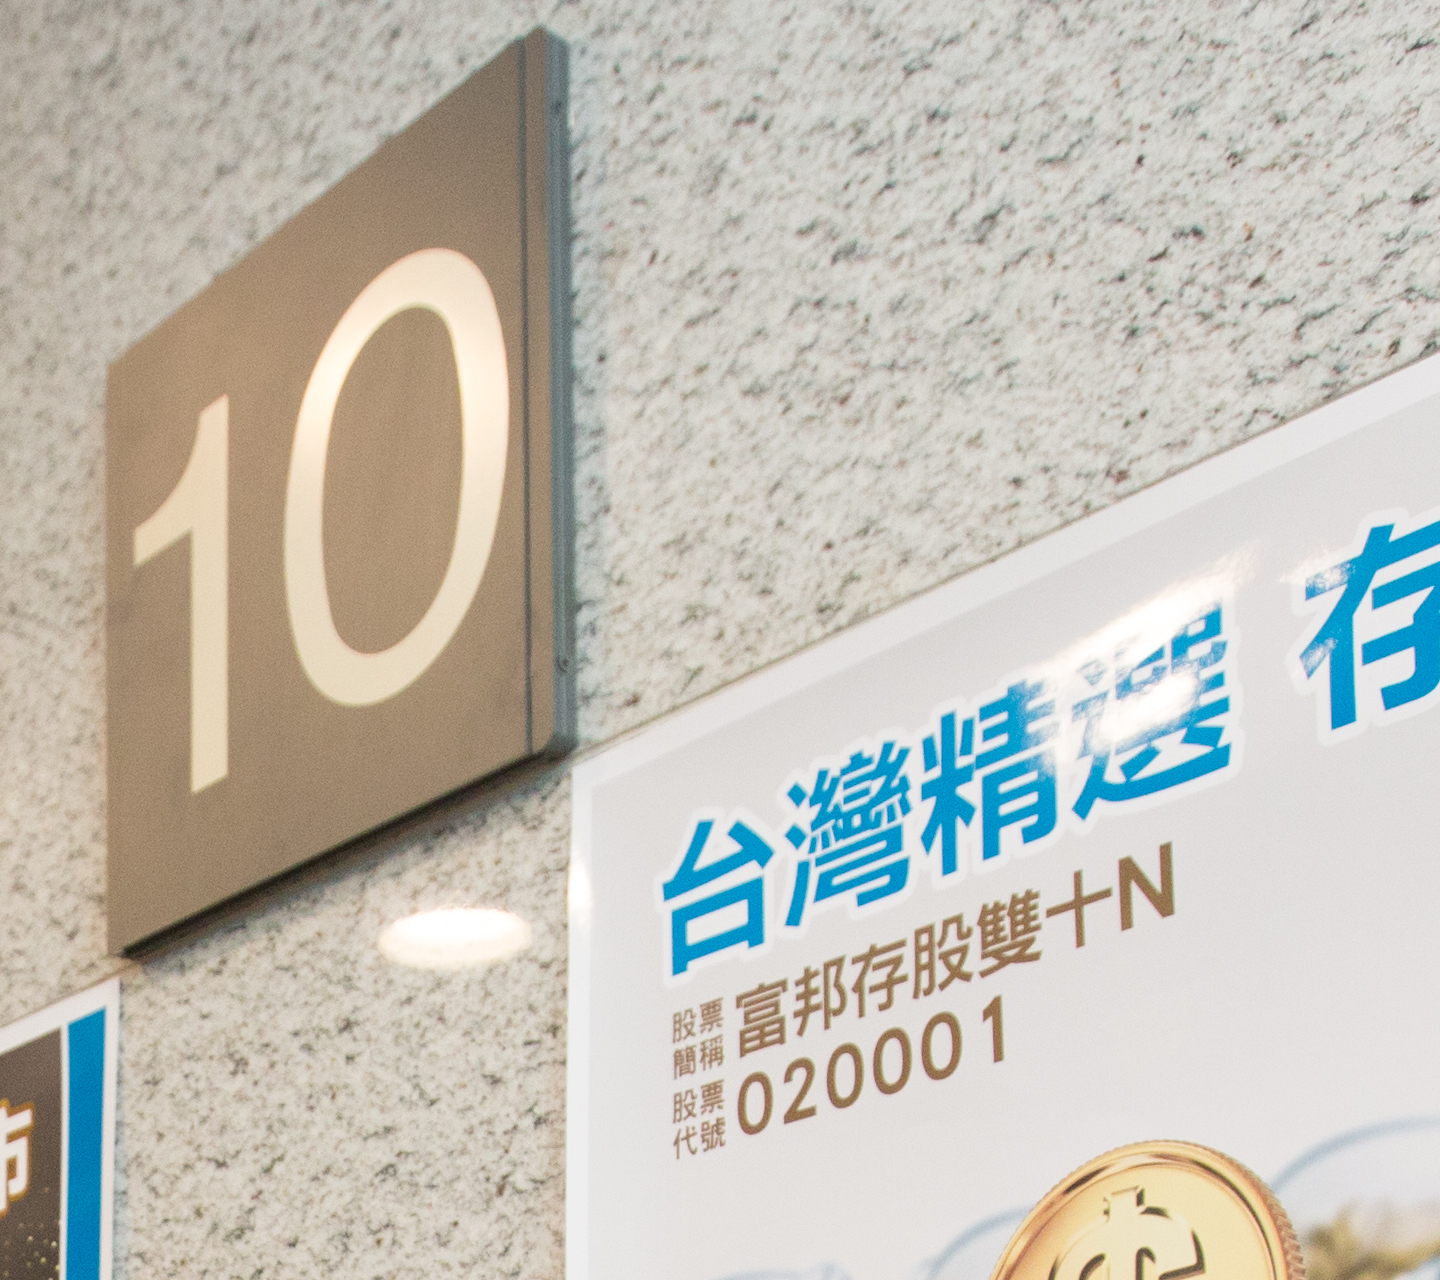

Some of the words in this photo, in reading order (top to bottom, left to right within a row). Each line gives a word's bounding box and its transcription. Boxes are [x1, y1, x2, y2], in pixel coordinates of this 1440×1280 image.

[132, 247, 511, 795] 10
[662, 596, 1232, 977] 台灣精選
[734, 840, 1176, 1058] 富邦存股雙十N
[671, 997, 725, 1044] 股票
[672, 1034, 725, 1080] 簡稱
[736, 994, 1006, 1136] 020001
[671, 1078, 726, 1124] 股票
[672, 1117, 727, 1160] 代號
